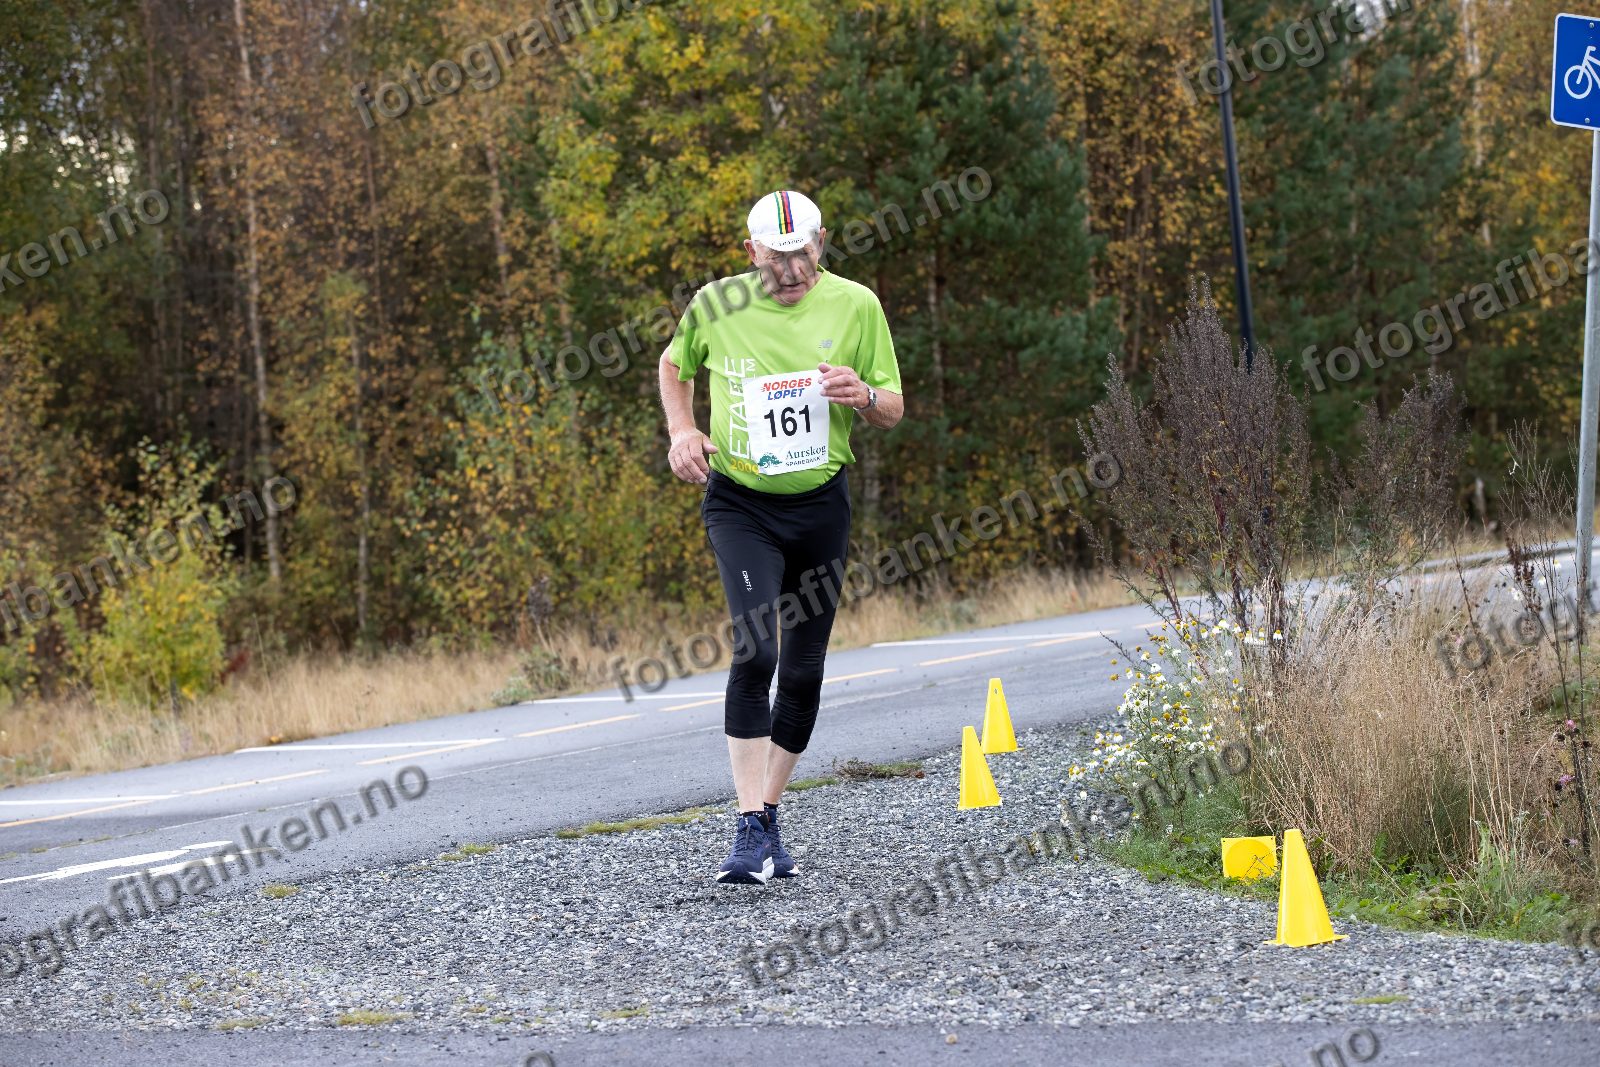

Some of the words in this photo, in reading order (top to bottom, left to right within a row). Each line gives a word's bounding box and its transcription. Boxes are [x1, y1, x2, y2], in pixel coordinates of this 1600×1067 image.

[763, 378, 812, 392] NORGES
[767, 388, 805, 401] LØPET
[764, 405, 811, 437] 161
[786, 445, 826, 460] Aurskog
